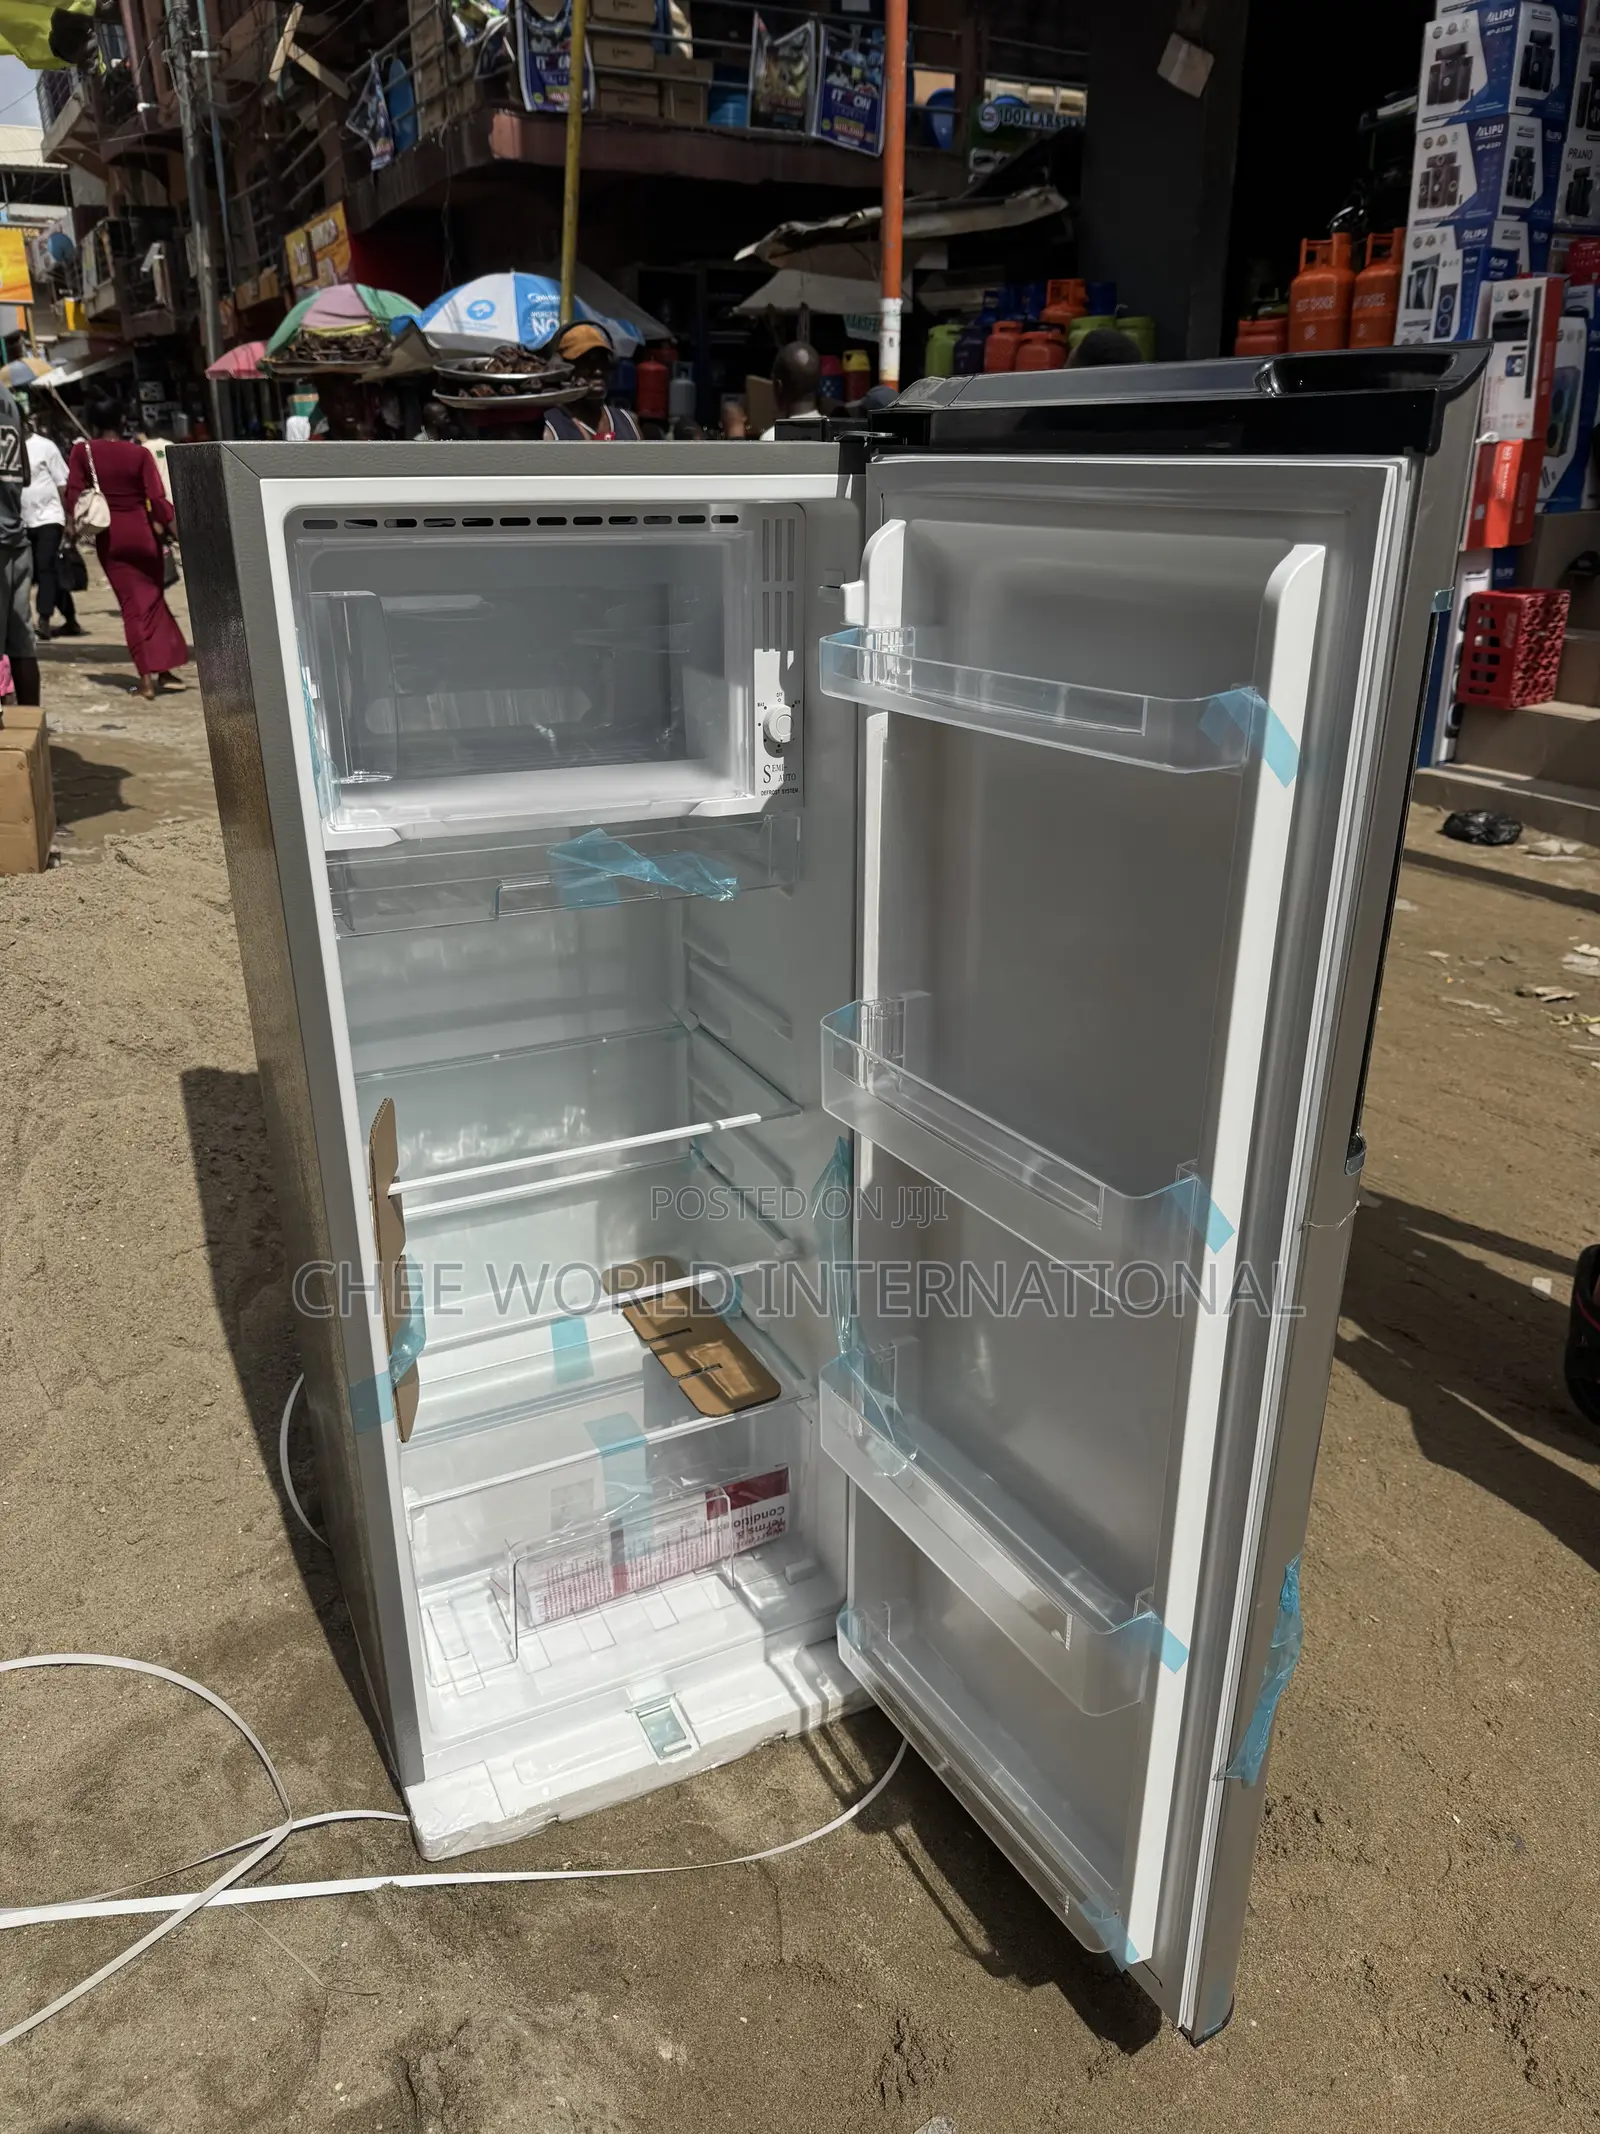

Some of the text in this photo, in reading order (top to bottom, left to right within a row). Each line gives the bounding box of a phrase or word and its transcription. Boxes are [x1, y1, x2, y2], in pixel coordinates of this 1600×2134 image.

[778, 773, 797, 782] AUTO
[760, 787, 799, 796] DEFROST SYSTEM
